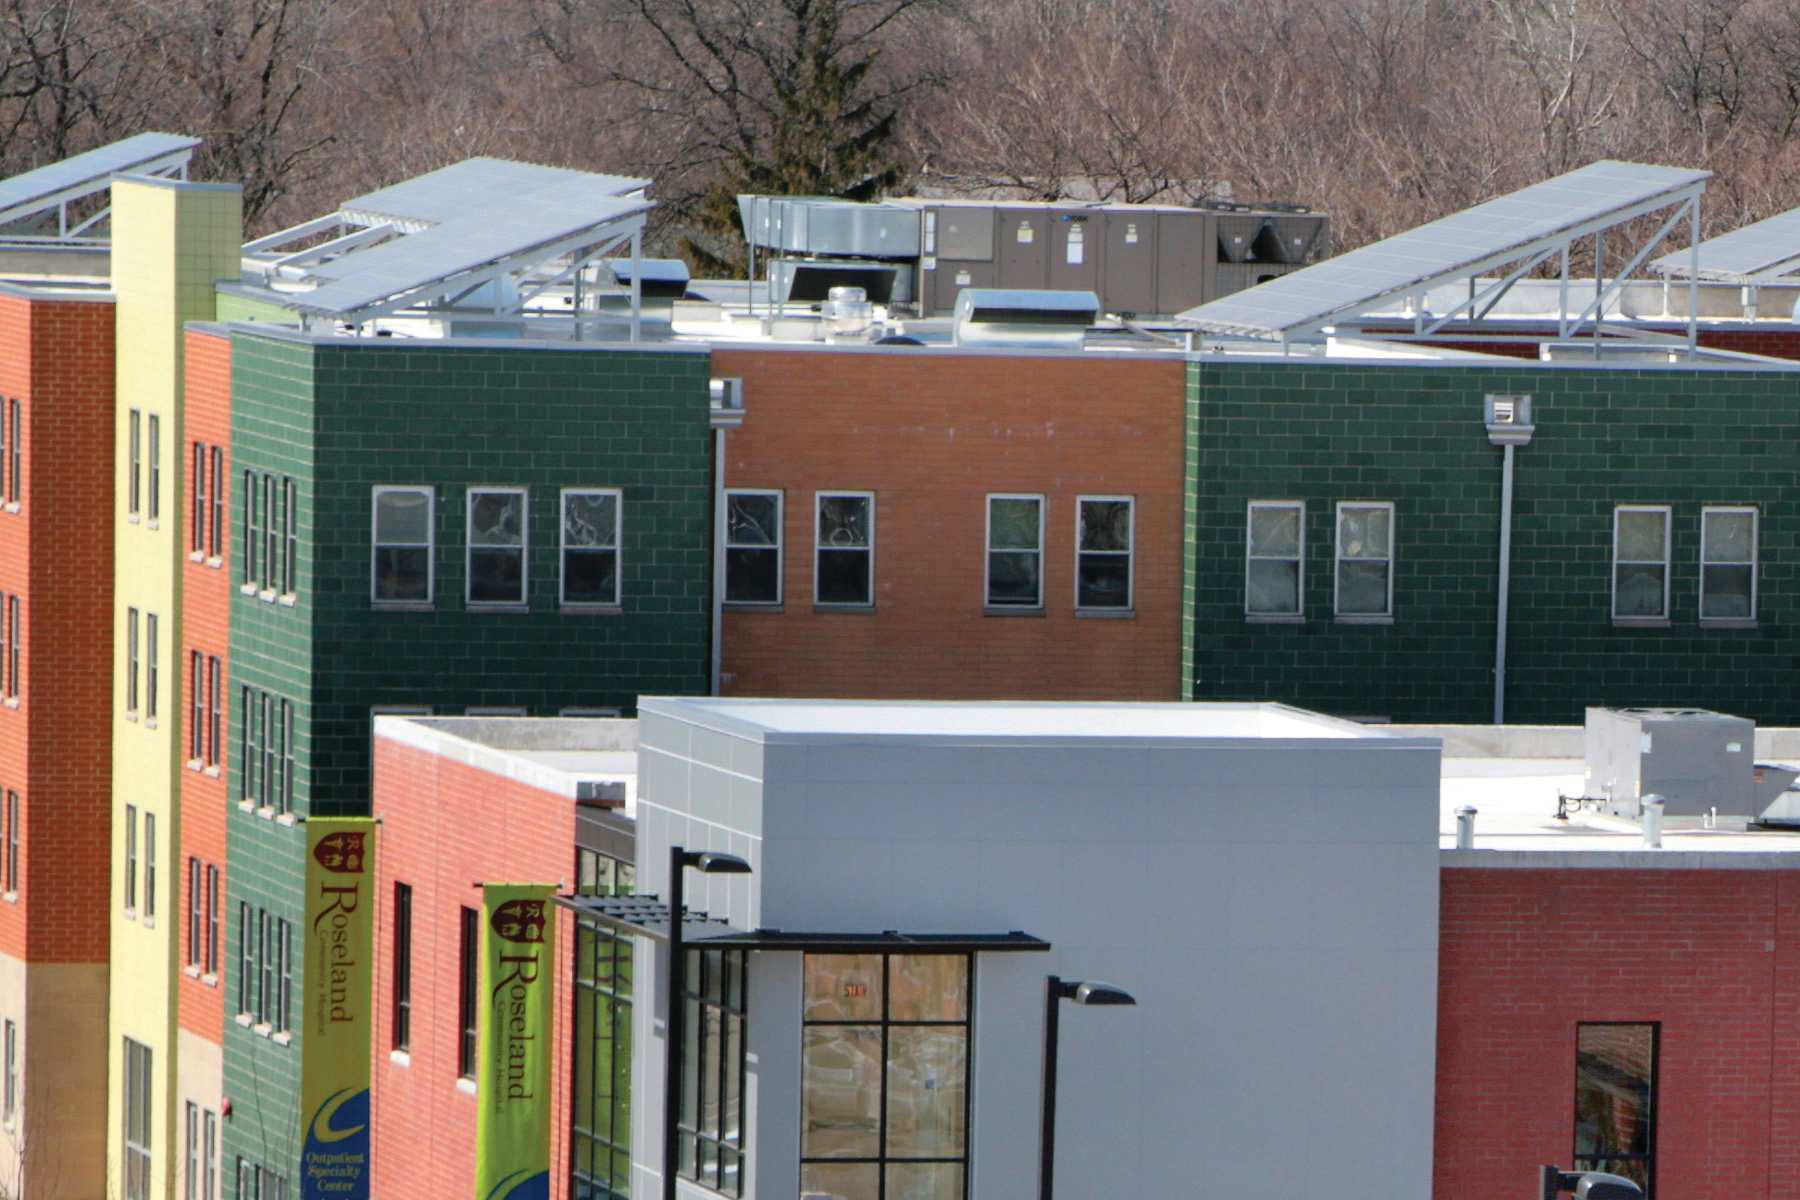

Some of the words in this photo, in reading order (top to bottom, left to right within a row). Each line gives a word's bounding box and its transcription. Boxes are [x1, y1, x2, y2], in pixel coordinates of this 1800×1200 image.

[313, 881, 359, 1021] Roseland
[491, 948, 539, 1101] Roseland
[307, 1165, 361, 1179] Specialty
[316, 1179, 355, 1192] Center
